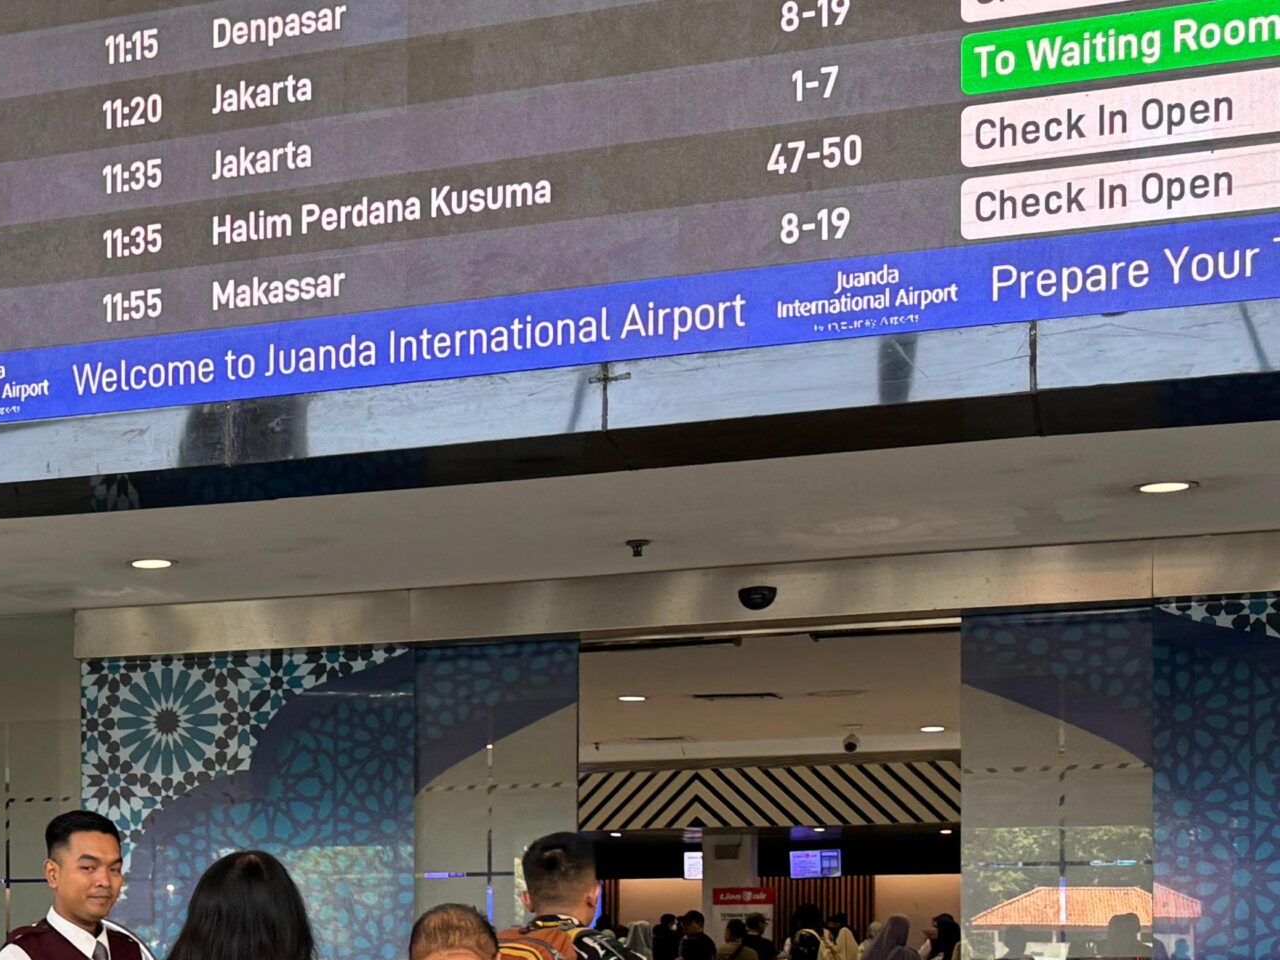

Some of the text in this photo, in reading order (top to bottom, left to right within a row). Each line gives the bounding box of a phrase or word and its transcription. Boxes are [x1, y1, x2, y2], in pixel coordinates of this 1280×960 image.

[212, 4, 346, 47] Denpasar
[780, 0, 850, 32] 8-19
[105, 29, 158, 64] 11:15
[974, 14, 1280, 79] To Waiting Room
[211, 75, 312, 114] Jakarta
[791, 65, 839, 102] 1-7
[103, 94, 162, 129] 11:20
[975, 96, 1233, 151] Check In Open
[211, 141, 312, 180] Jakarta
[766, 134, 862, 175] 47-50
[103, 159, 162, 194] 11:35
[212, 179, 551, 246] Halim Perdana Kusuma
[975, 171, 1233, 222] Check In Open
[103, 224, 162, 259] 11:35
[780, 206, 851, 245] 8-19
[212, 272, 346, 311] Makassar
[833, 263, 899, 294] Juanda
[992, 246, 1260, 302] Prepare Your
[103, 288, 162, 323] 11:55
[777, 283, 959, 319] International Airport
[72, 294, 746, 396] Welcome to Juanda International Airport
[1, 379, 50, 402] Airport
